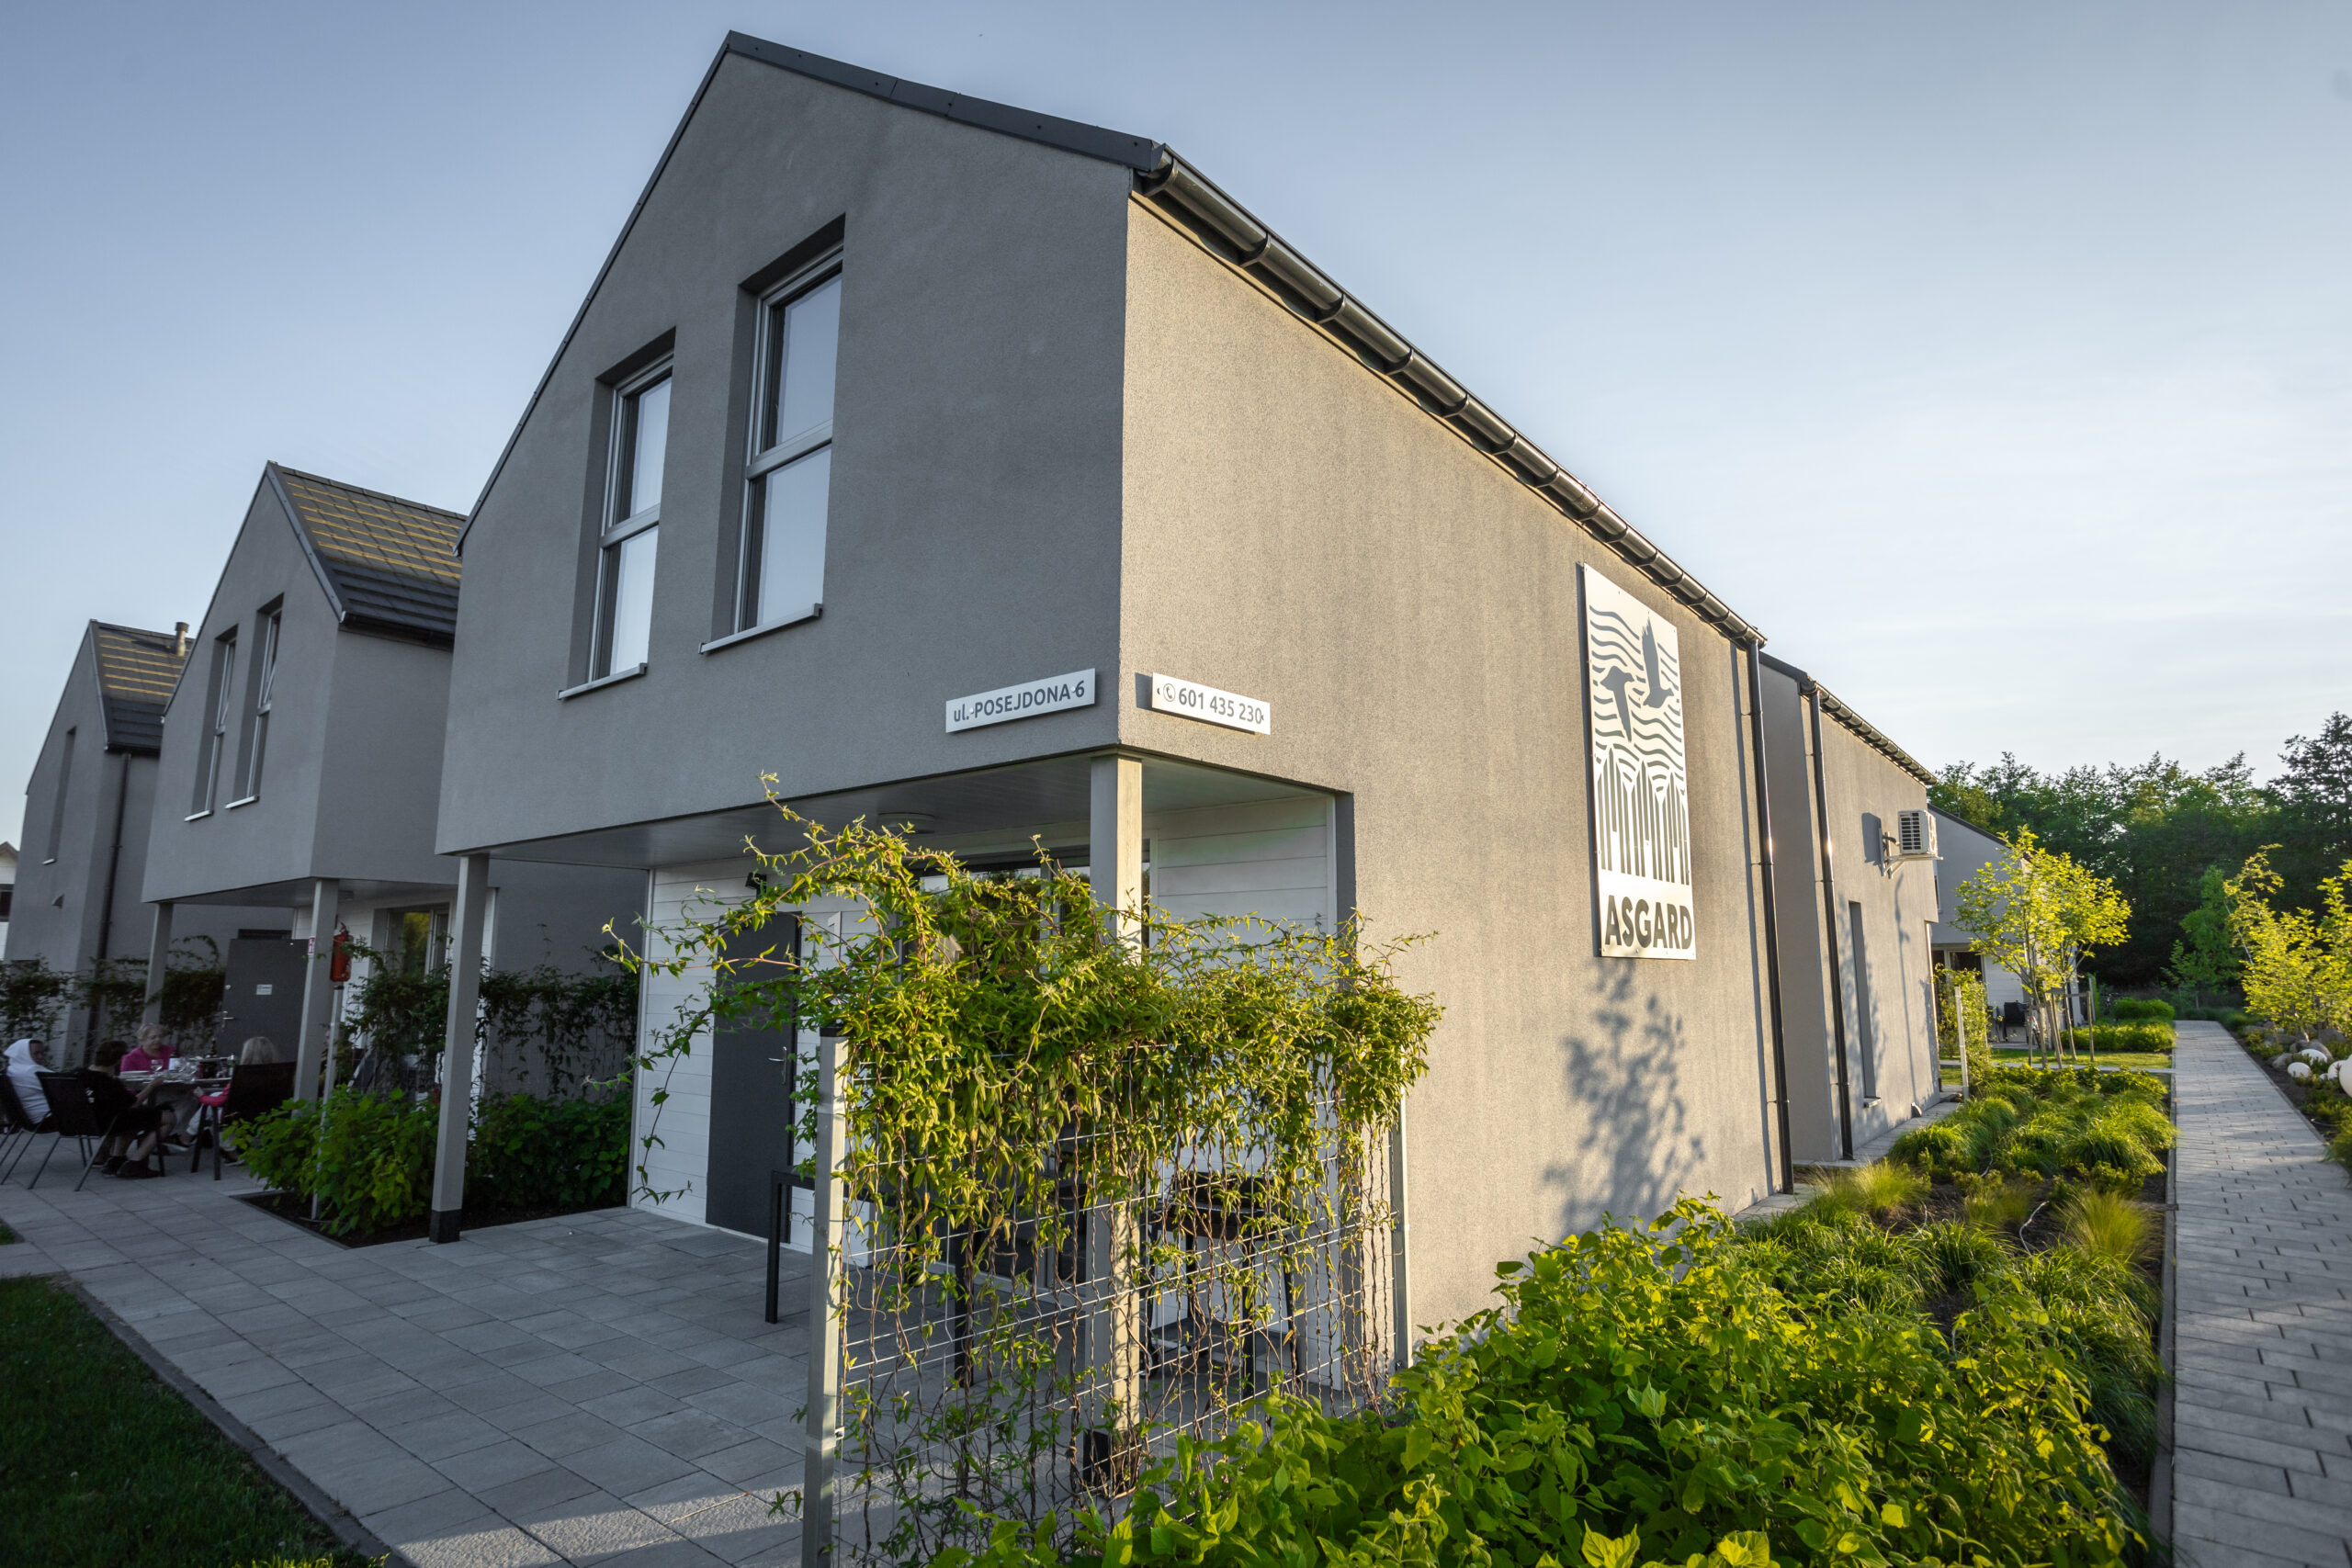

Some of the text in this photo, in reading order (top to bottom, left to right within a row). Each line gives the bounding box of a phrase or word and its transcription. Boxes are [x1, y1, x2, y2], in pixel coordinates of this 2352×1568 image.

[954, 680, 1085, 722] ul. POSEJDONA 6
[1179, 687, 1262, 725] 601 435 230
[1605, 895, 1692, 950] ASGARD
